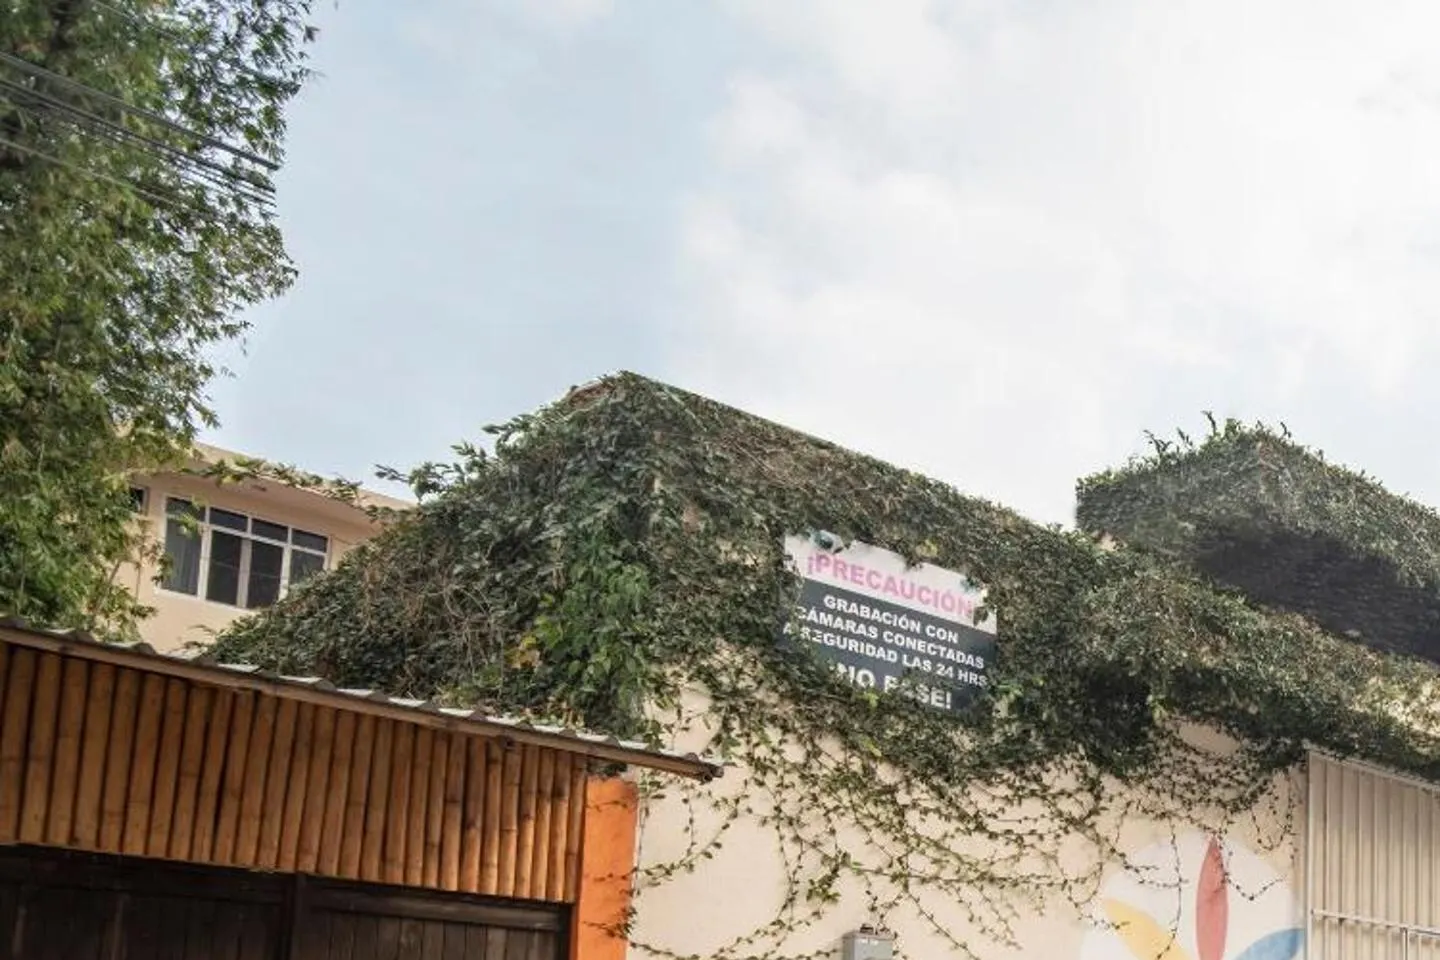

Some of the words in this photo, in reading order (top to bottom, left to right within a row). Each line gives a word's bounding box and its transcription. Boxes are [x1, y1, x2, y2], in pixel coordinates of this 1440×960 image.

[795, 605, 878, 639] CÁMARAS
[883, 631, 985, 669] CONECTADAS
[823, 595, 921, 634] GRABACIÓN
[925, 624, 958, 644] CON
[902, 653, 932, 672] LAS
[936, 662, 954, 679] 24
[958, 669, 988, 687] HRS
